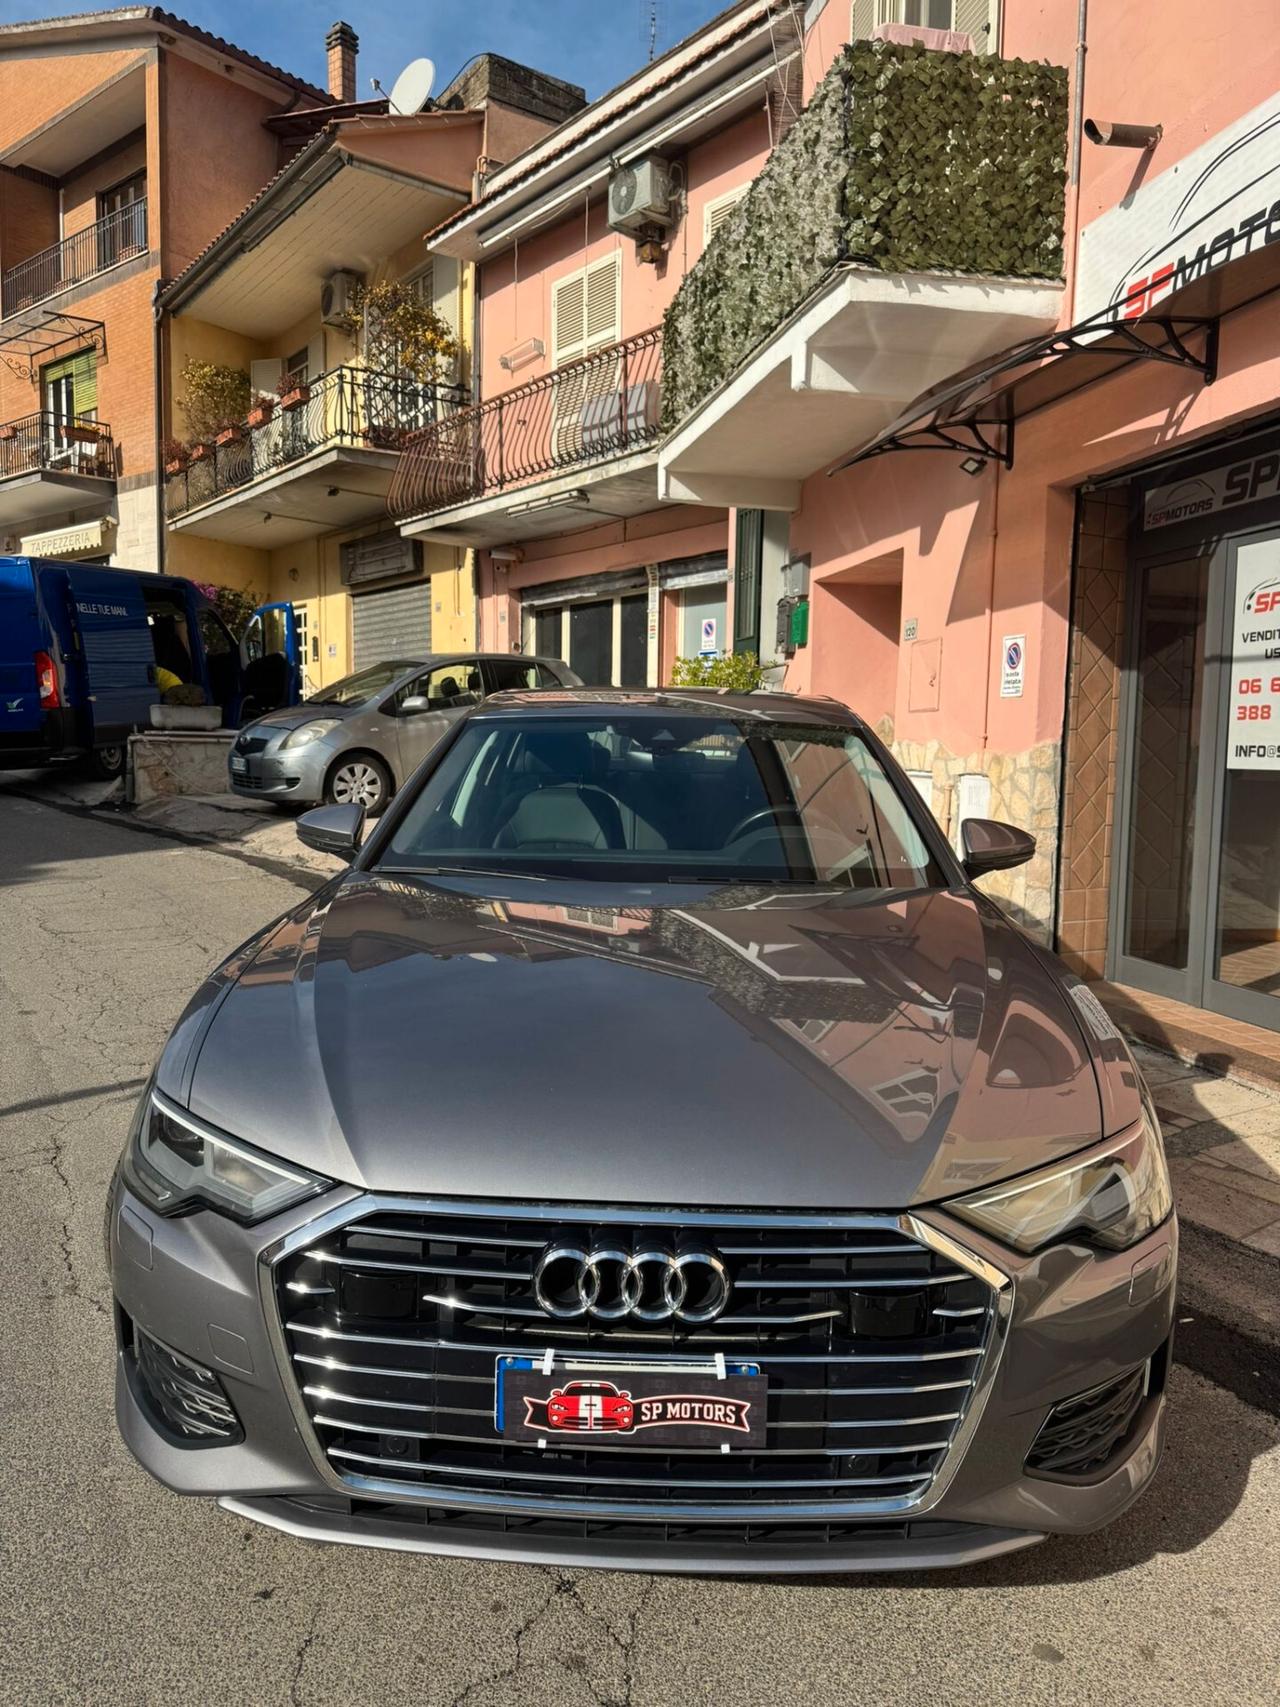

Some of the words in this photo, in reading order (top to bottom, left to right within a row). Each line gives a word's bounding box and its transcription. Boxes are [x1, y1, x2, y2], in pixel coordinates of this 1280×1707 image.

[1222, 454, 1280, 505] SP
[31, 532, 90, 553] TAPPEZZERIA
[1238, 678, 1262, 694] 06
[1237, 704, 1271, 720] 388
[641, 1402, 663, 1421] SP
[666, 1402, 736, 1424] MOTORS
